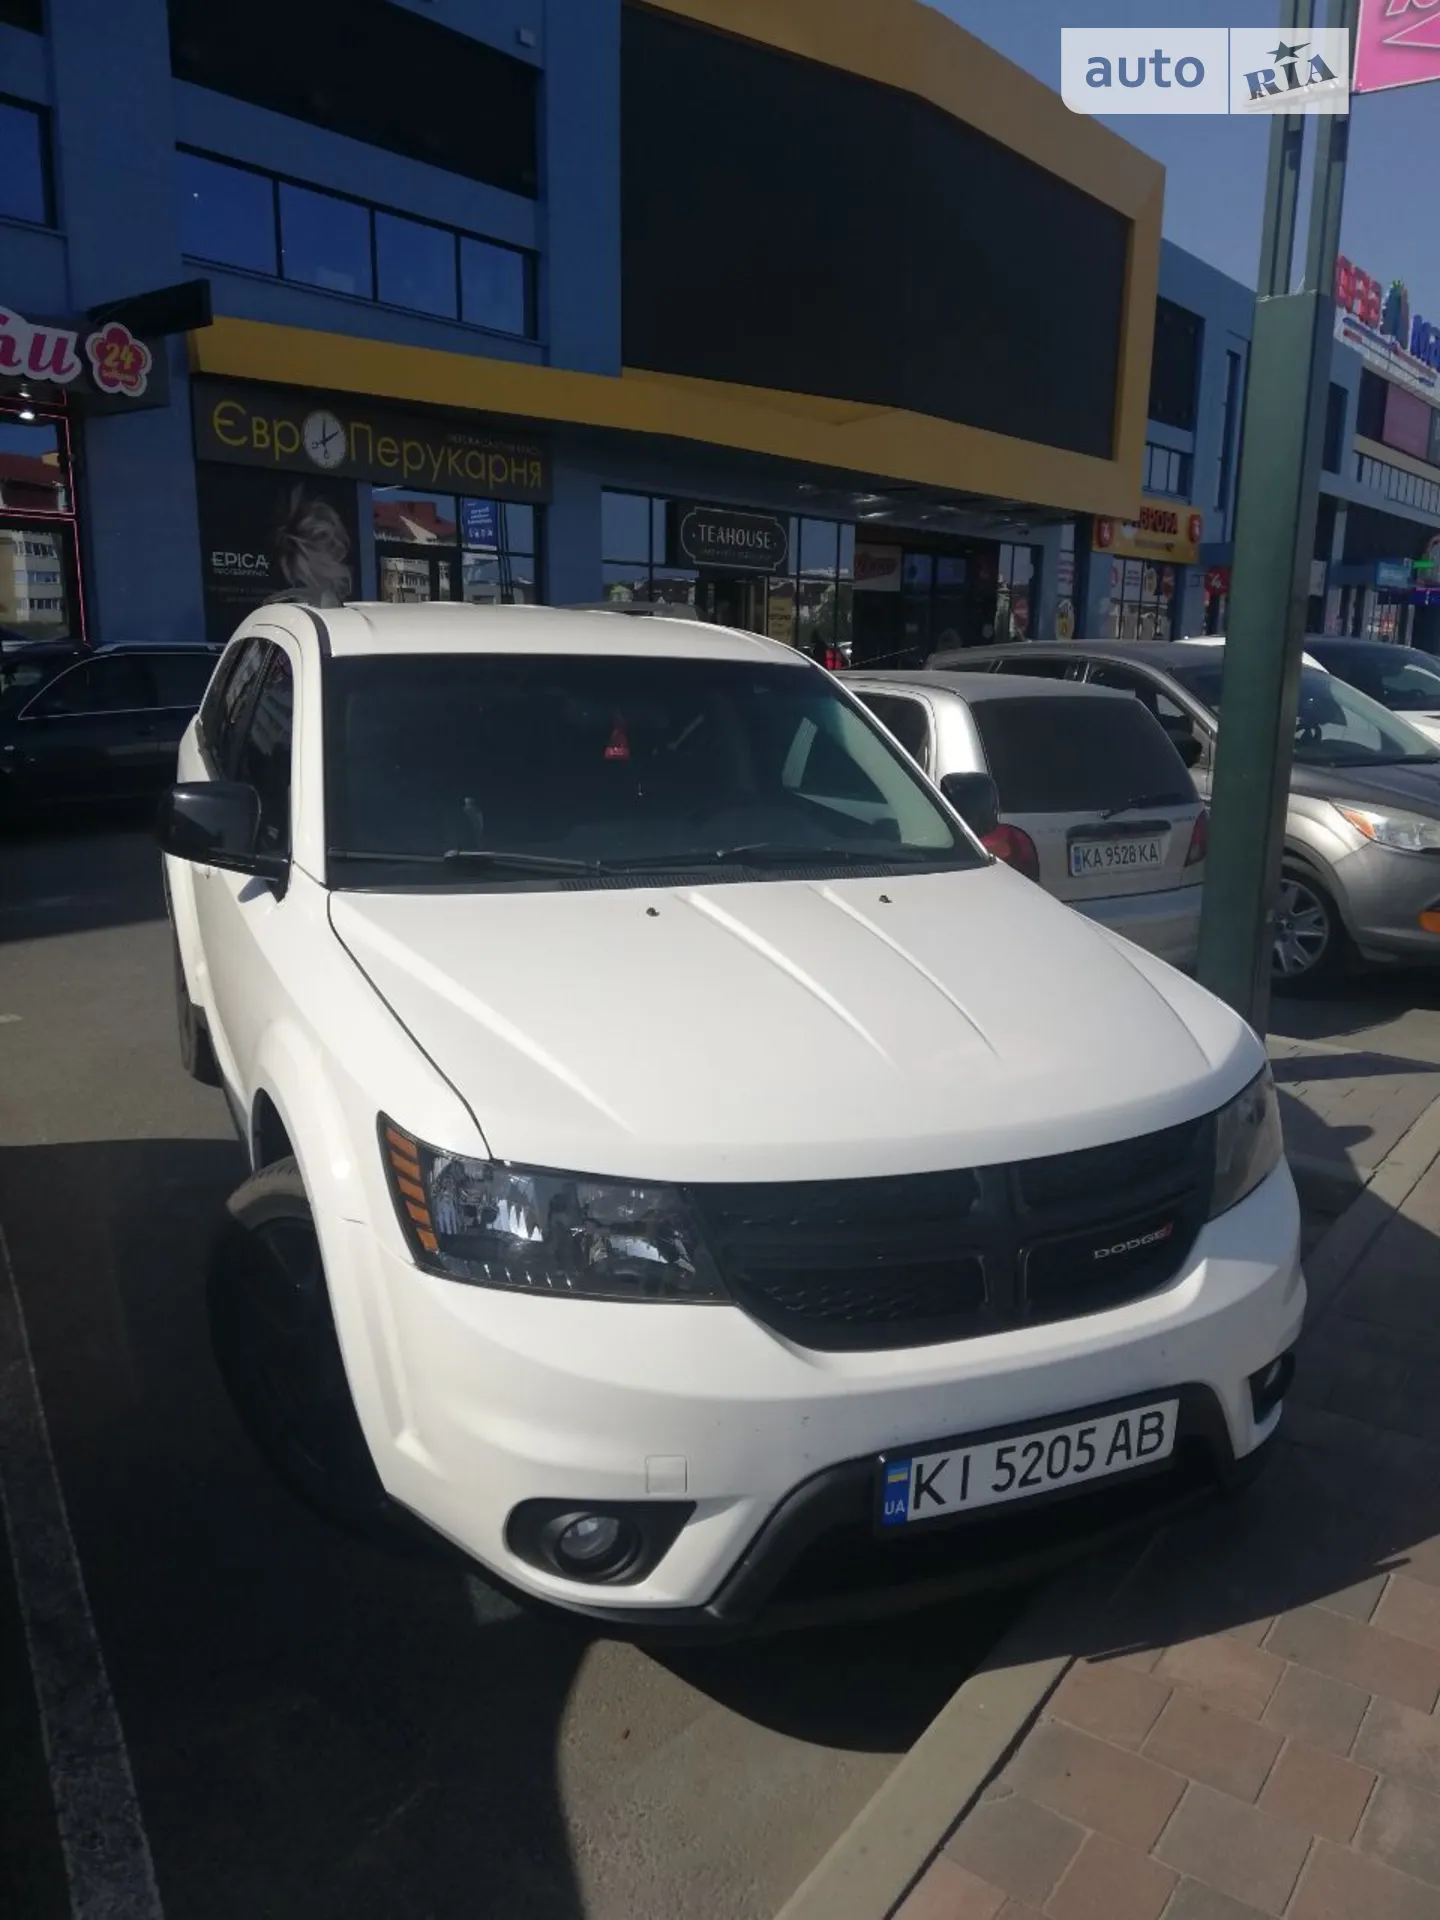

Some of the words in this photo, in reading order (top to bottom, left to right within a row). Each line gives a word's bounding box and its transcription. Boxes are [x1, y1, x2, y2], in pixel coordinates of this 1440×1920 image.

[104, 343, 135, 369] 24
[698, 524, 772, 550] TEAHOUSE
[211, 551, 269, 569] EPICA
[1082, 848, 1103, 869] KA
[1139, 843, 1159, 863] KA
[1093, 1229, 1167, 1260] DODGE
[912, 1454, 972, 1511] KI
[991, 1426, 1097, 1494] 5205
[1105, 1411, 1166, 1466] AB
[884, 1499, 906, 1515] UA
